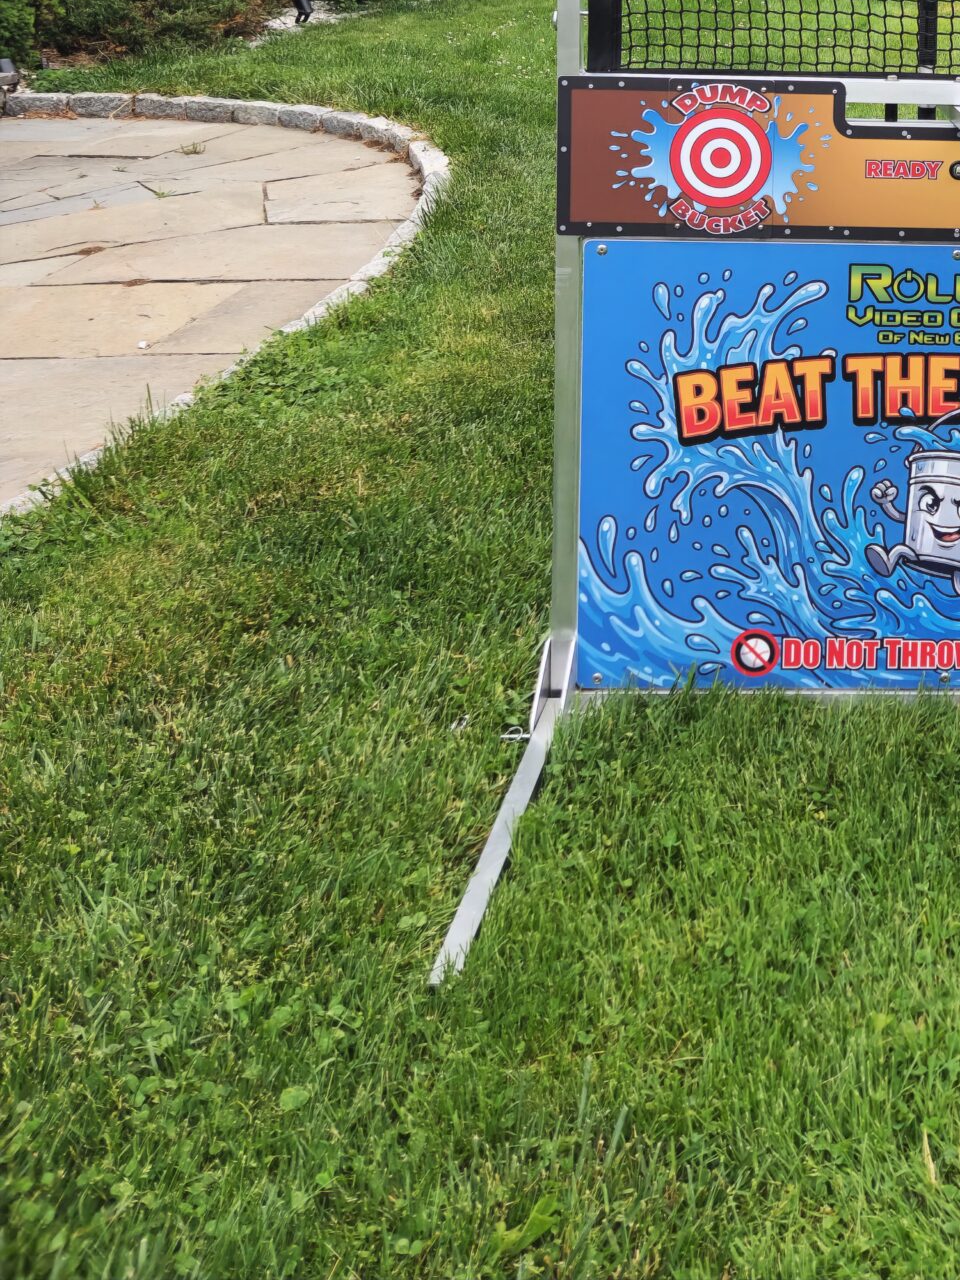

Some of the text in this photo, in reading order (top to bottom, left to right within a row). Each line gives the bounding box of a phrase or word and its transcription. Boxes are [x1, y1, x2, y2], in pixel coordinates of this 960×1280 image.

[671, 83, 772, 116] DUMP
[865, 159, 943, 180] READY
[669, 198, 772, 235] BUCKET
[846, 305, 944, 327] VIDEO
[877, 330, 905, 345] OF
[908, 330, 949, 345] NEW
[674, 356, 835, 445] BEAT
[843, 353, 960, 424] THE
[782, 638, 821, 669] DO
[826, 637, 880, 670] NOT
